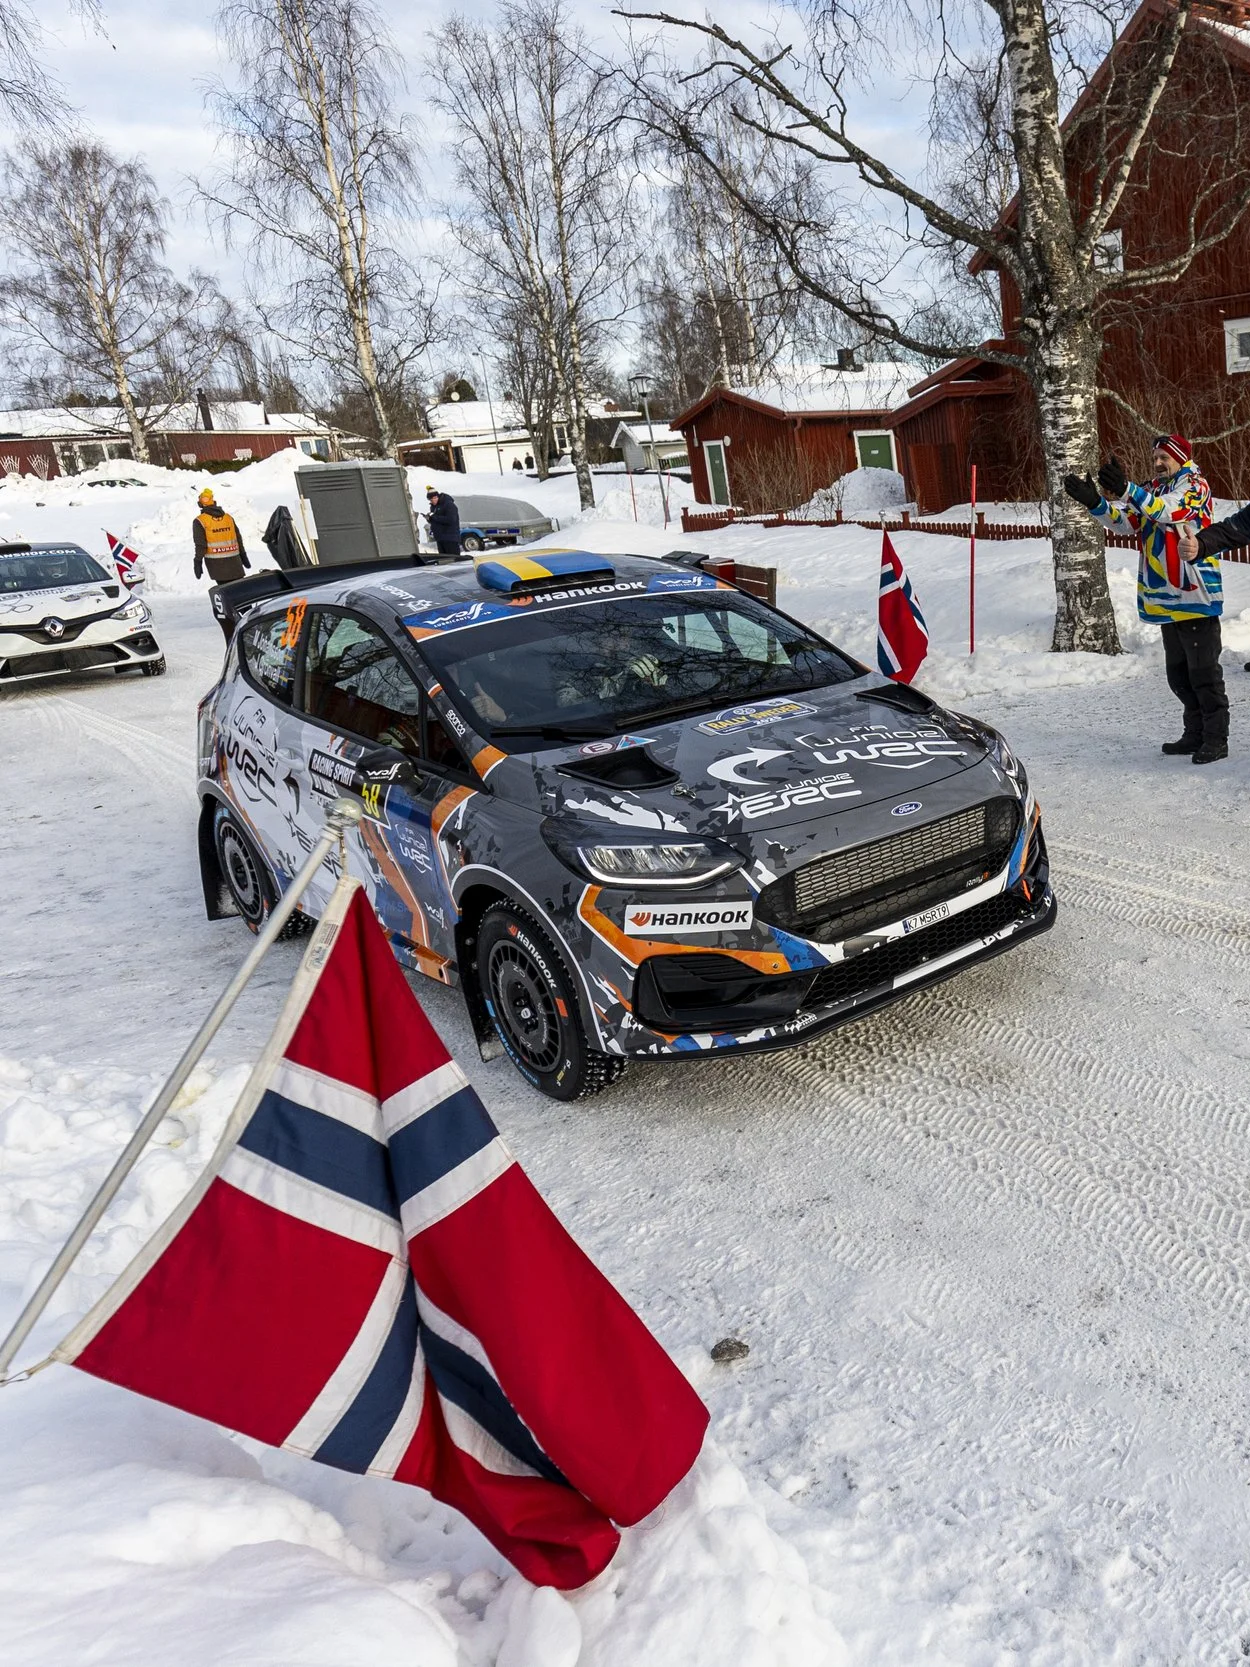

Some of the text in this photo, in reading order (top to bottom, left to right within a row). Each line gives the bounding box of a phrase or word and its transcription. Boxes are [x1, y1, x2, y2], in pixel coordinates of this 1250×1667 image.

[281, 597, 307, 648] 58
[253, 708, 267, 728] FIA
[706, 703, 802, 730] RALLY SWEDEN
[849, 724, 888, 733] FIA
[814, 730, 943, 747] JUNIOR
[813, 740, 968, 764] WRC
[311, 753, 335, 778] RACING
[333, 763, 356, 787] SPIRIT
[776, 772, 852, 793] JUNIOR
[362, 782, 381, 818] 58
[741, 779, 862, 819] ERC
[897, 803, 917, 814] Ford
[908, 904, 948, 931] K7 MSRT9
